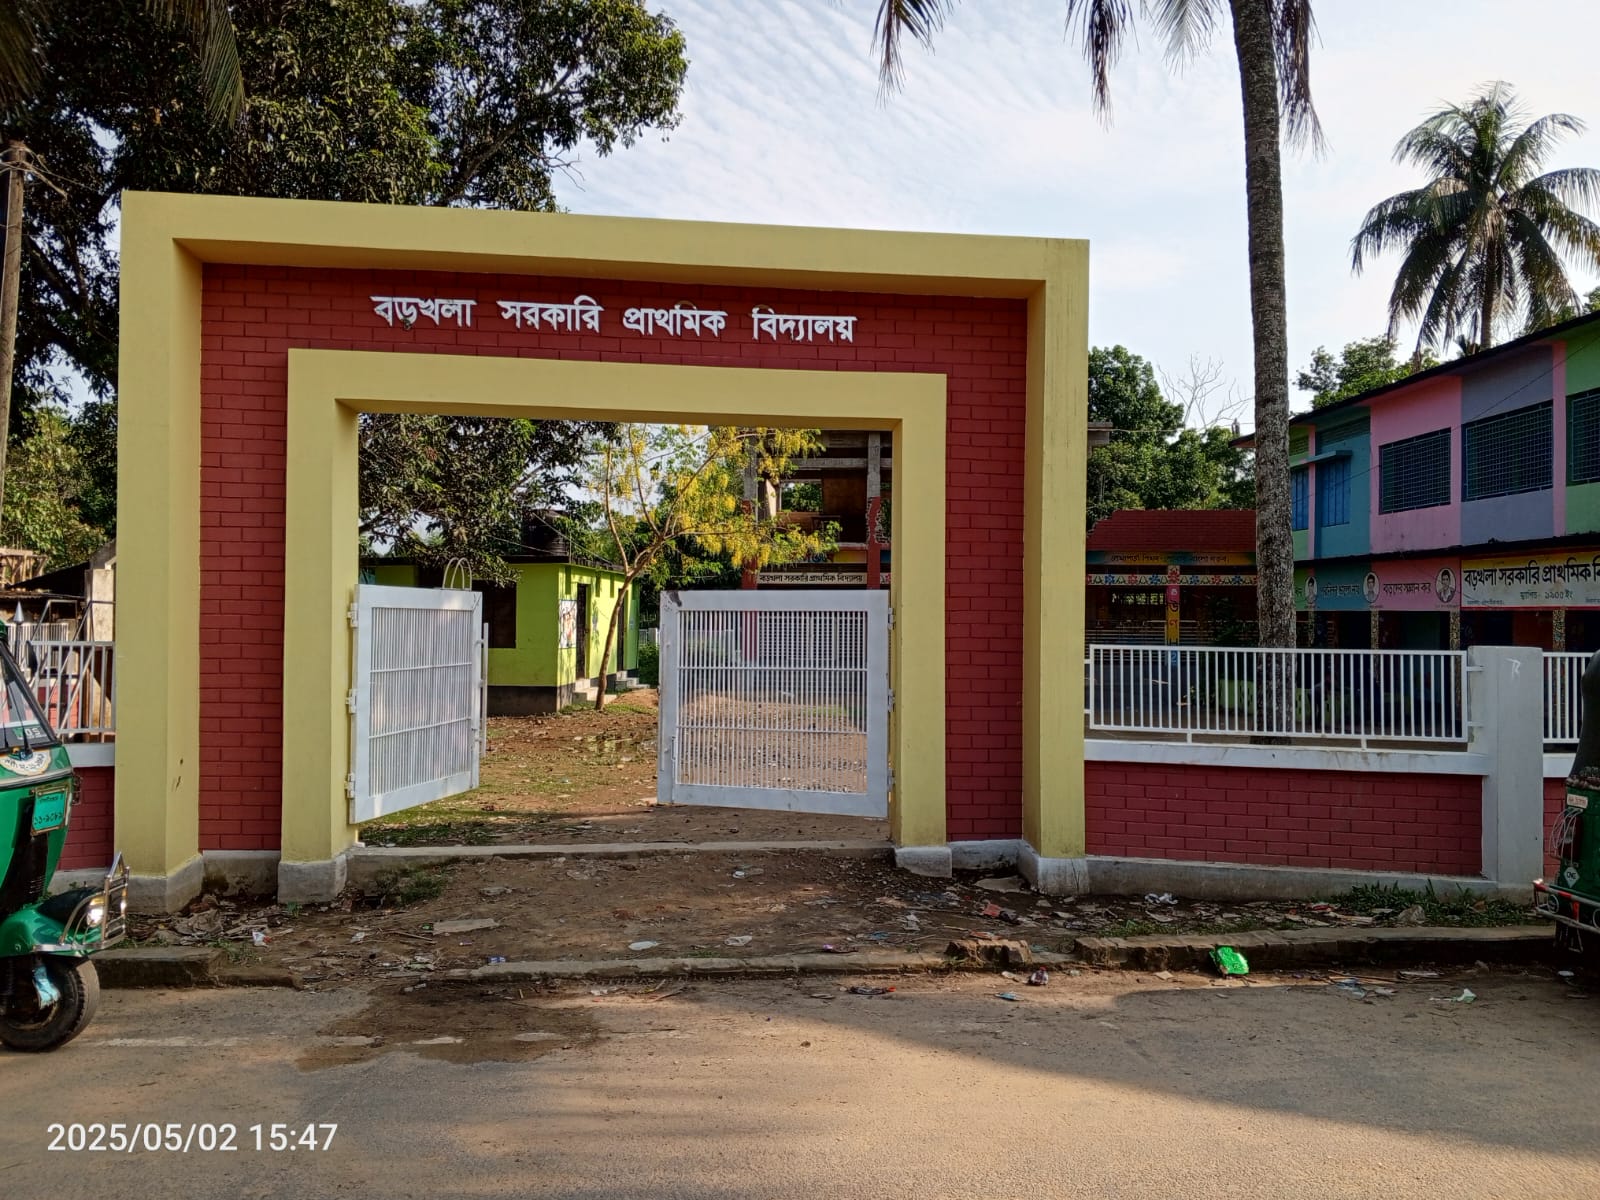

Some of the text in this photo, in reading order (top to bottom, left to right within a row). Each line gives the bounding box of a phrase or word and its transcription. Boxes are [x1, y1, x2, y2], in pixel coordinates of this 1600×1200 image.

[370, 294, 858, 343] বড়খলা সরকারি প্রাথমিক বিদ্যালয়
[1463, 568, 1498, 591] বড়খলা
[1499, 560, 1540, 586] সরকারি
[1542, 557, 1592, 582] প্রাথমিক
